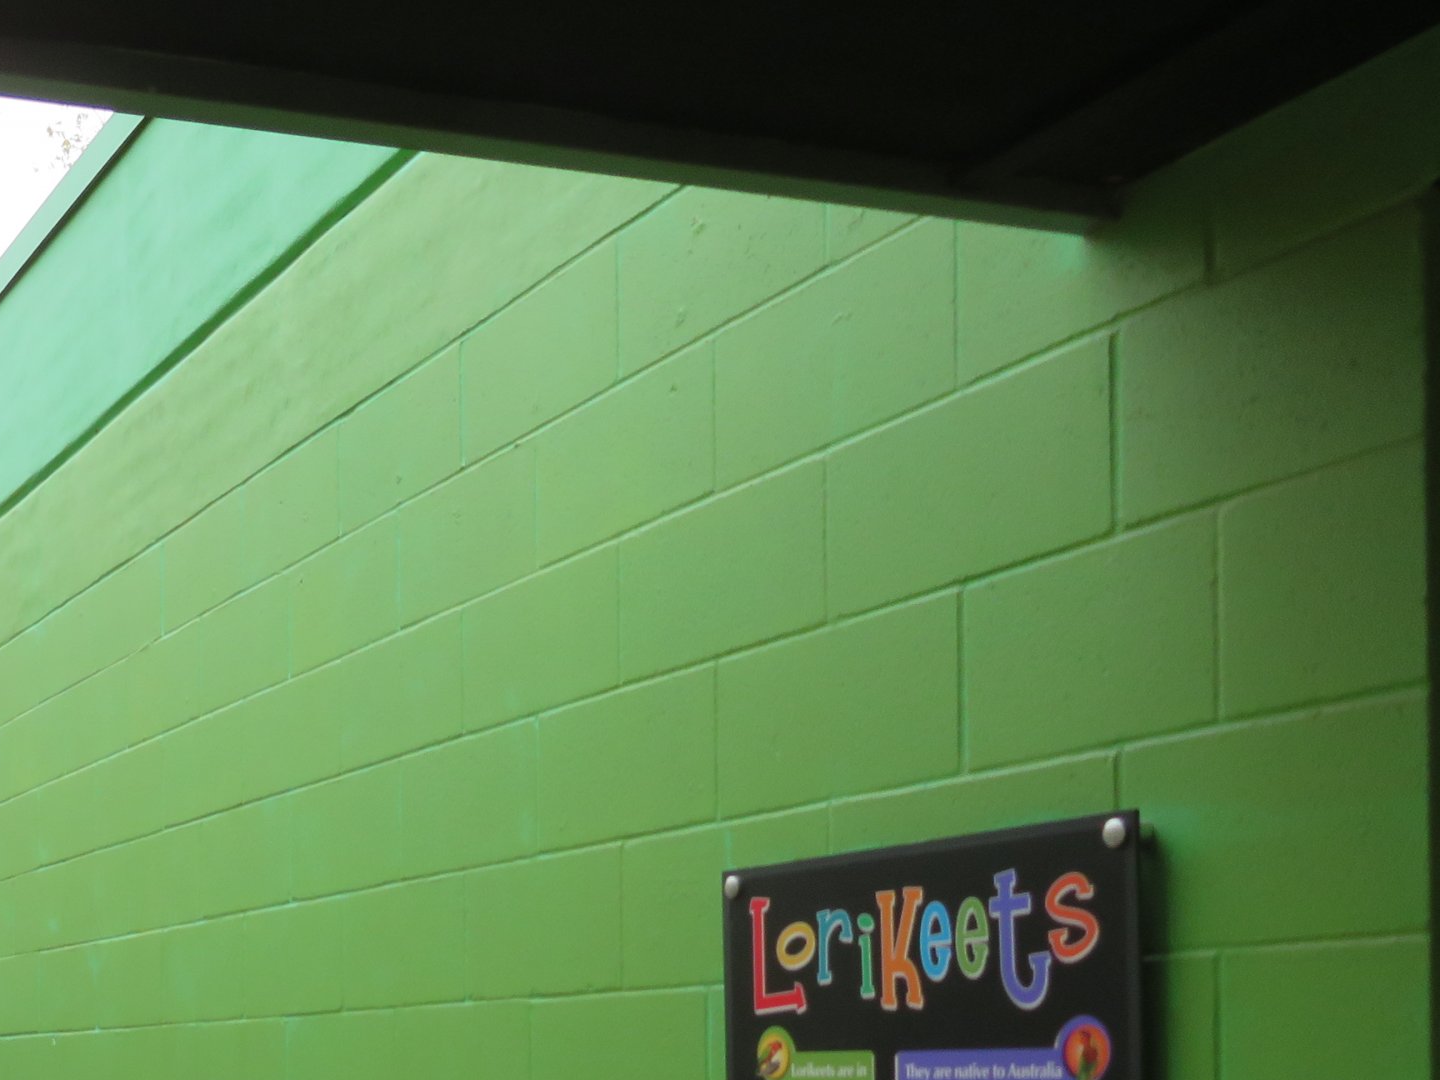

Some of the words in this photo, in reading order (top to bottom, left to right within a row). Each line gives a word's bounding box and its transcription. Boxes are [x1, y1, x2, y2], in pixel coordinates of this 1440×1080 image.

[791, 1062, 835, 1078] Lorikeets
[837, 1065, 854, 1078] are
[856, 1061, 867, 1077] in
[933, 1065, 952, 1079] are
[954, 1062, 990, 1079] native
[992, 1064, 1006, 1079] to
[1007, 1060, 1064, 1080] Australia
